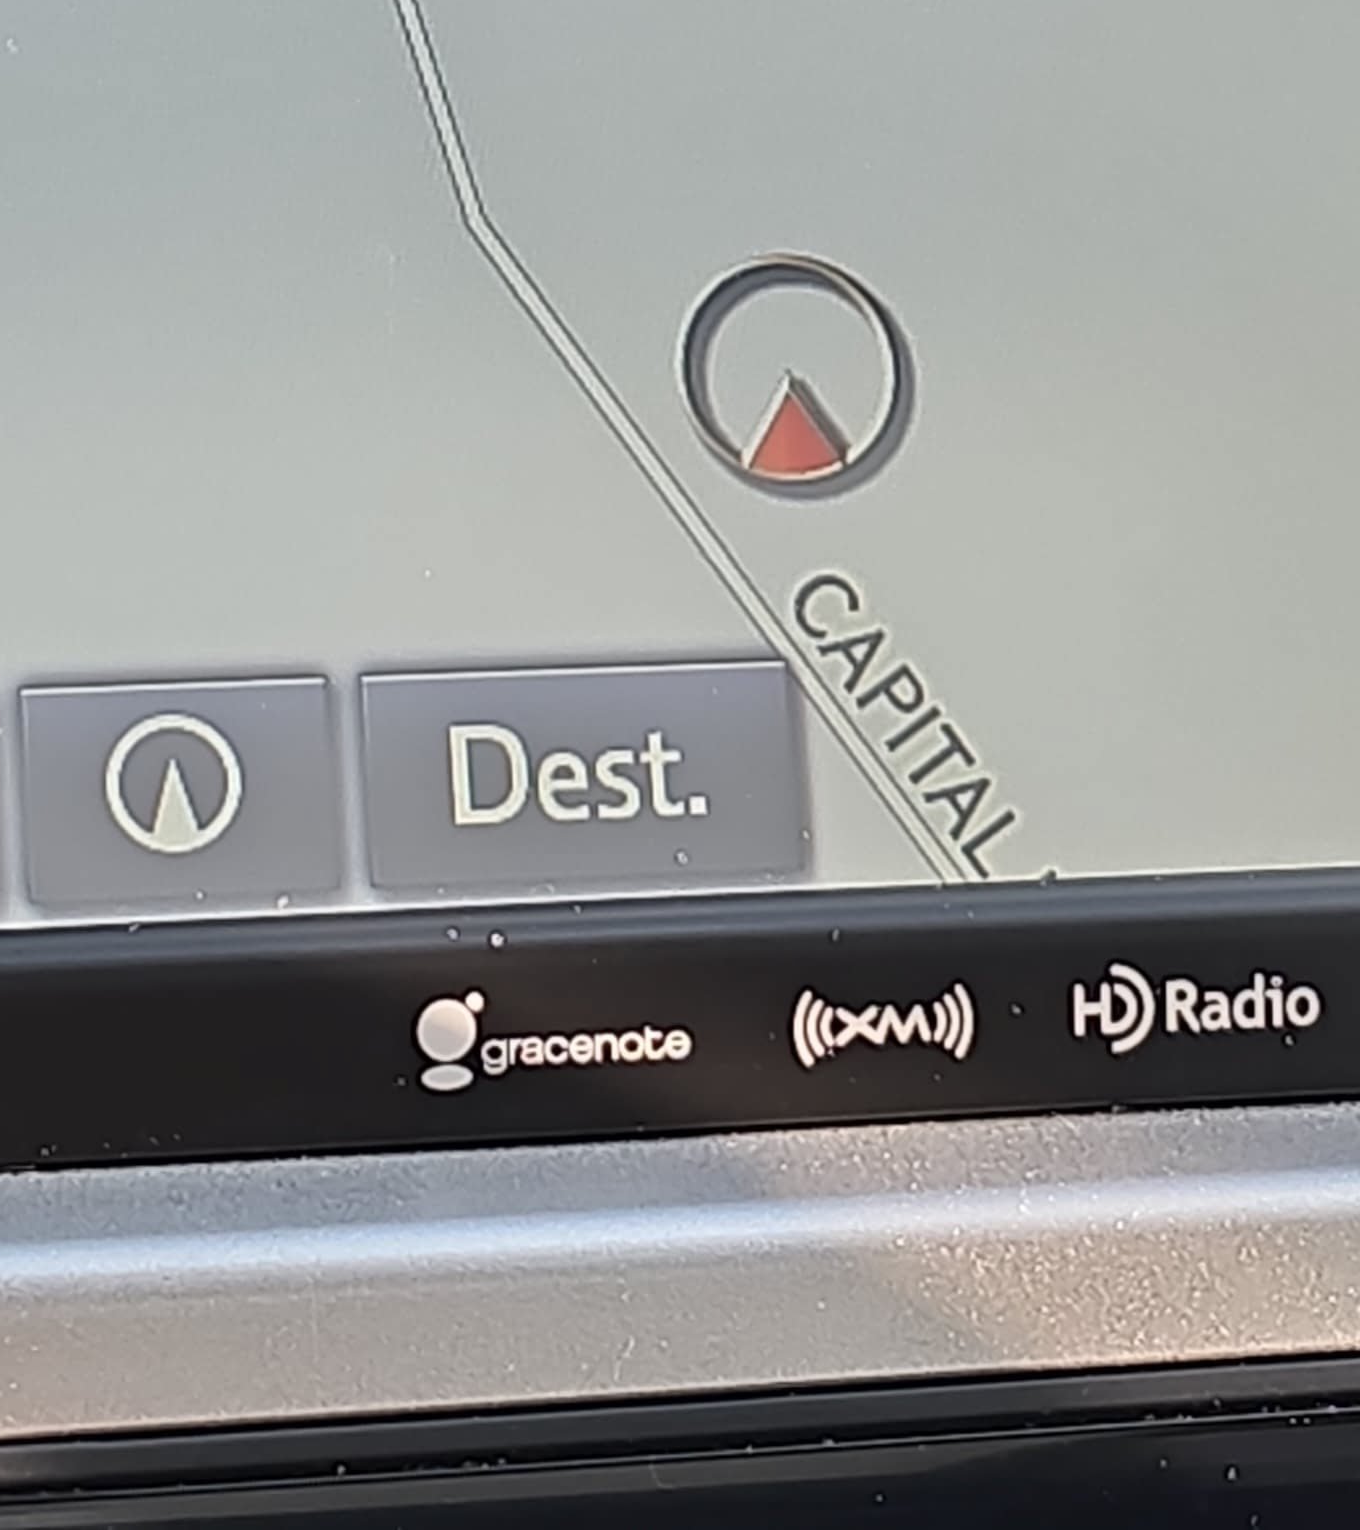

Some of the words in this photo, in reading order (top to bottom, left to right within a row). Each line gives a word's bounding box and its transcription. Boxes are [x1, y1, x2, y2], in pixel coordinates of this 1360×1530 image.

[447, 724, 710, 826] Dest.
[793, 573, 1016, 880] CAPITAL
[480, 1024, 693, 1072] gracenote
[1072, 962, 1157, 1054] HD
[1163, 973, 1321, 1034] Radio
